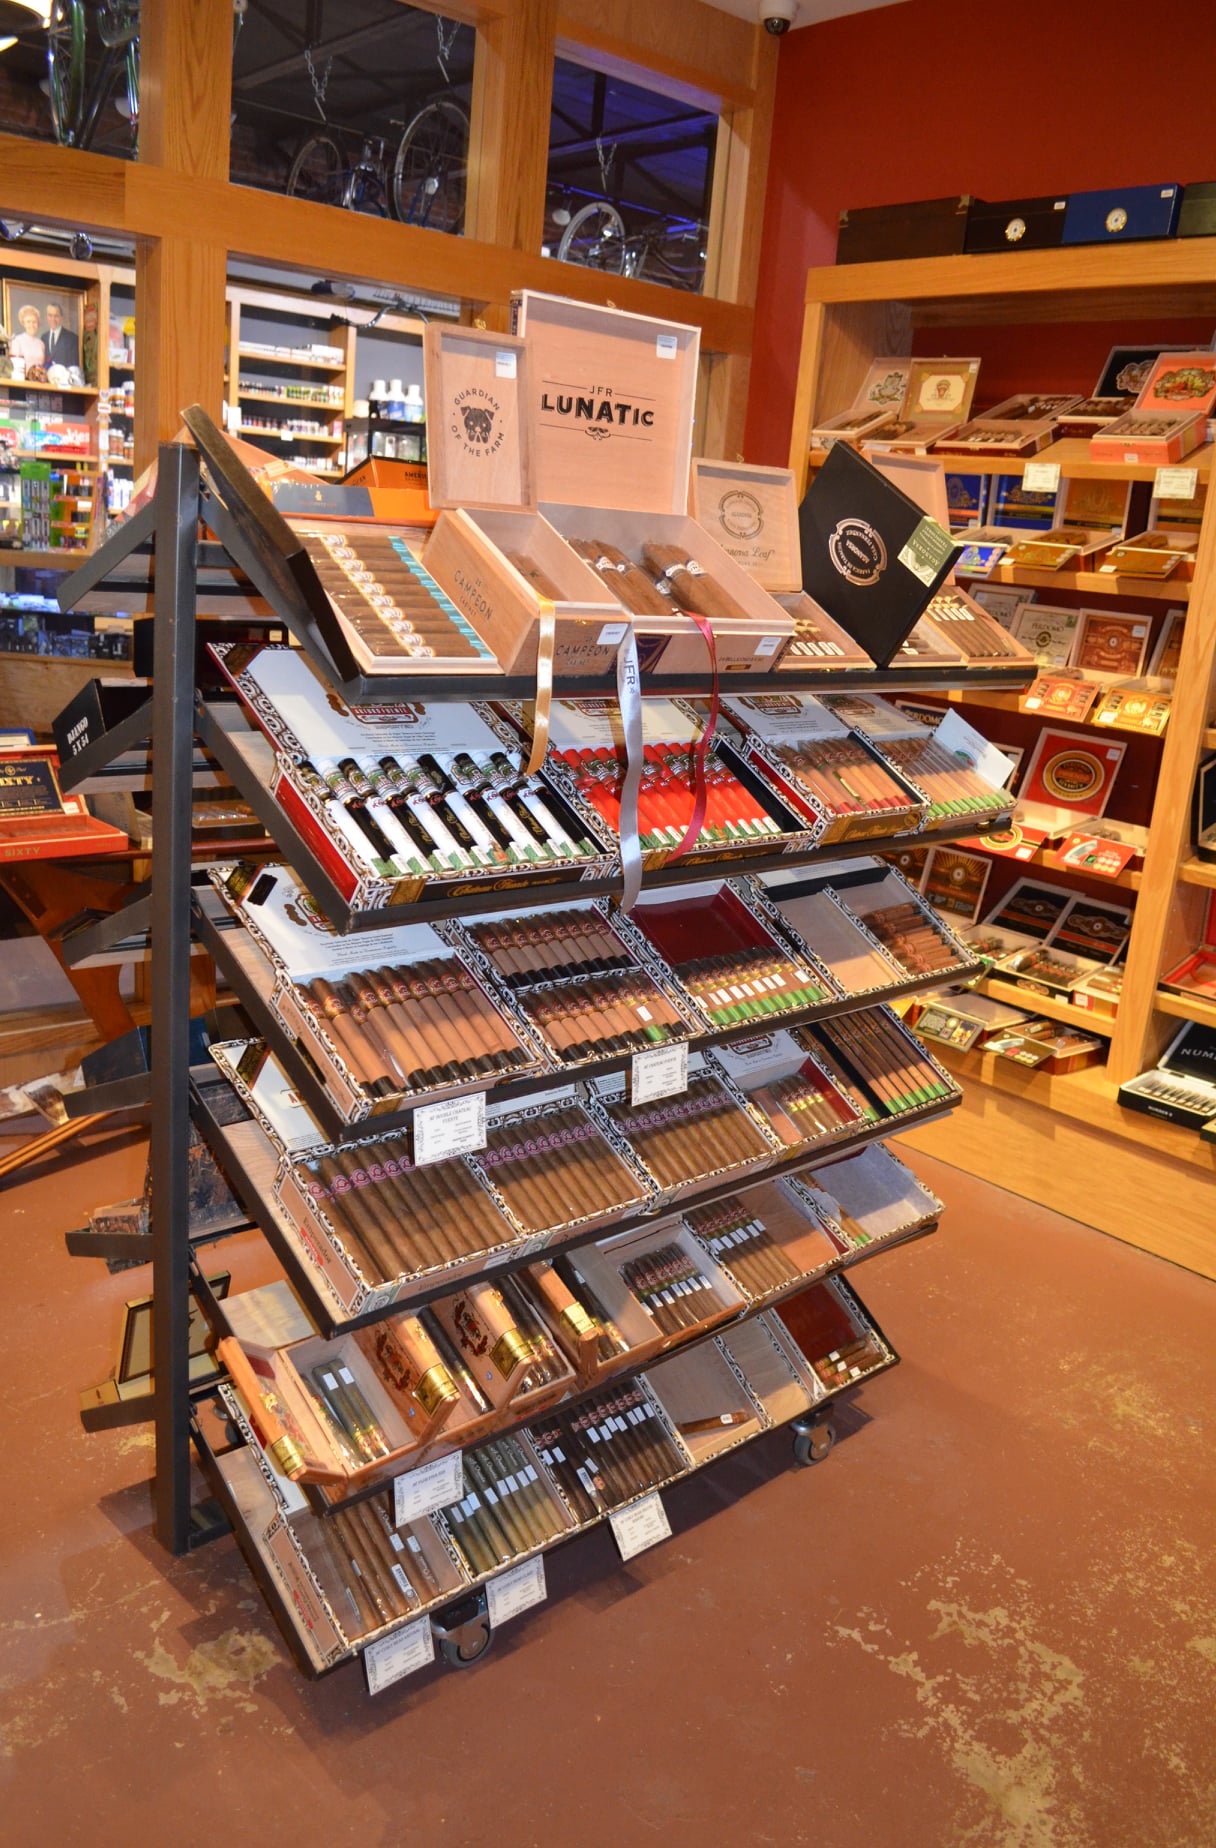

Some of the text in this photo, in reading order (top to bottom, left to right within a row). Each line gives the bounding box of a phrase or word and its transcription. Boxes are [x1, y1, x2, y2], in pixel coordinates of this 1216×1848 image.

[454, 388, 500, 411] GUARDIAN
[589, 385, 613, 397] JFR
[541, 393, 654, 426] LUNATIC
[451, 425, 505, 457] OF THE FARM
[751, 546, 775, 561] Leaf
[454, 570, 493, 620] CAMPEON
[555, 645, 610, 657] CAMPEON
[623, 657, 636, 685] JFR
[0, 775, 33, 786] IXTY
[4, 847, 40, 857] SIXTY
